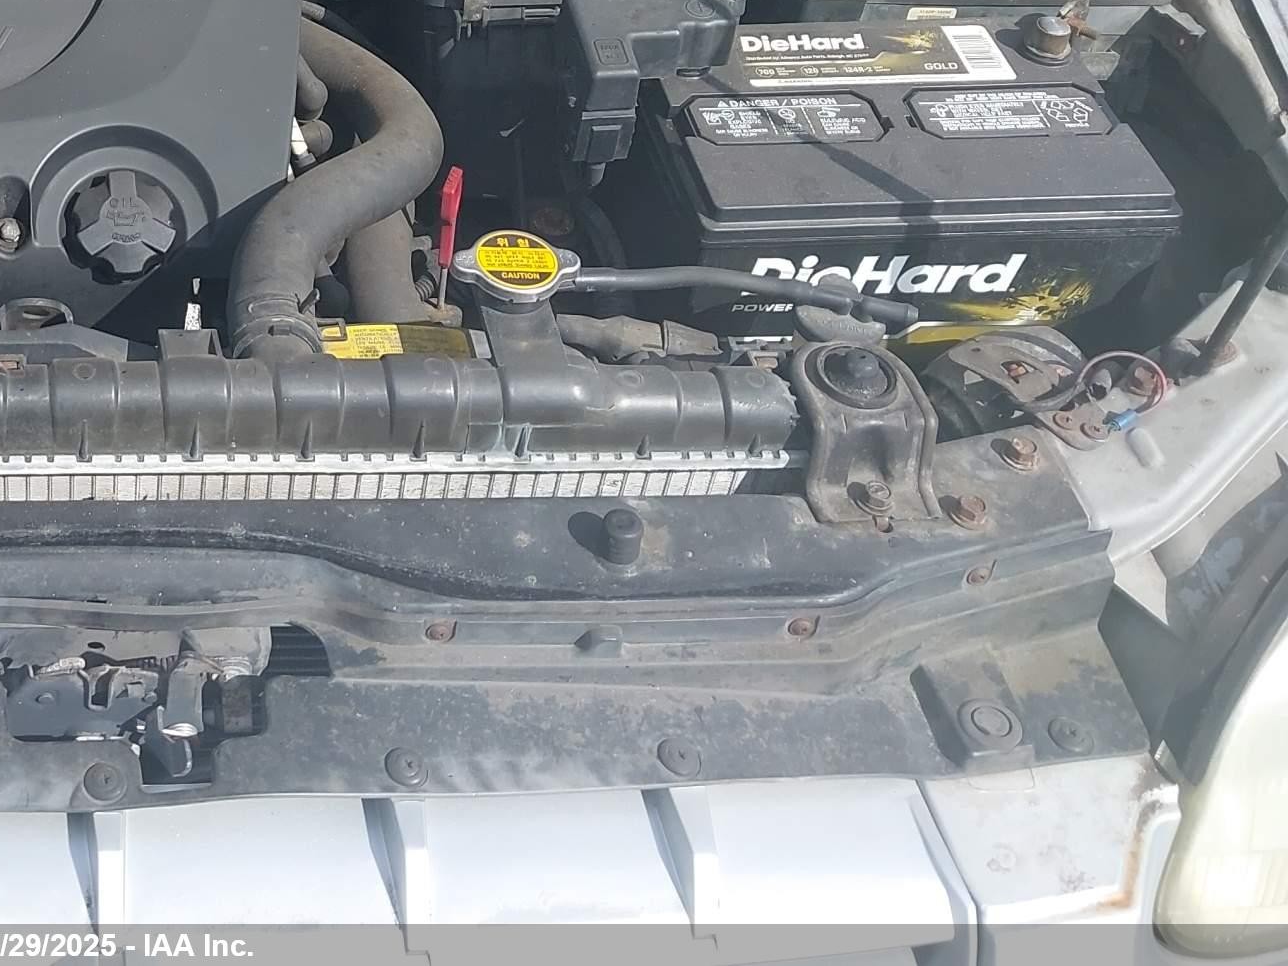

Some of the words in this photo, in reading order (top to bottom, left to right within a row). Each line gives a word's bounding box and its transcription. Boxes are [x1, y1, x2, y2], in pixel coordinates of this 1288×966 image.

[740, 34, 866, 52] DieHard
[924, 62, 958, 70] GOLD
[729, 99, 779, 107] DANGER
[790, 97, 837, 106] POISON
[502, 272, 540, 280] CAUTION
